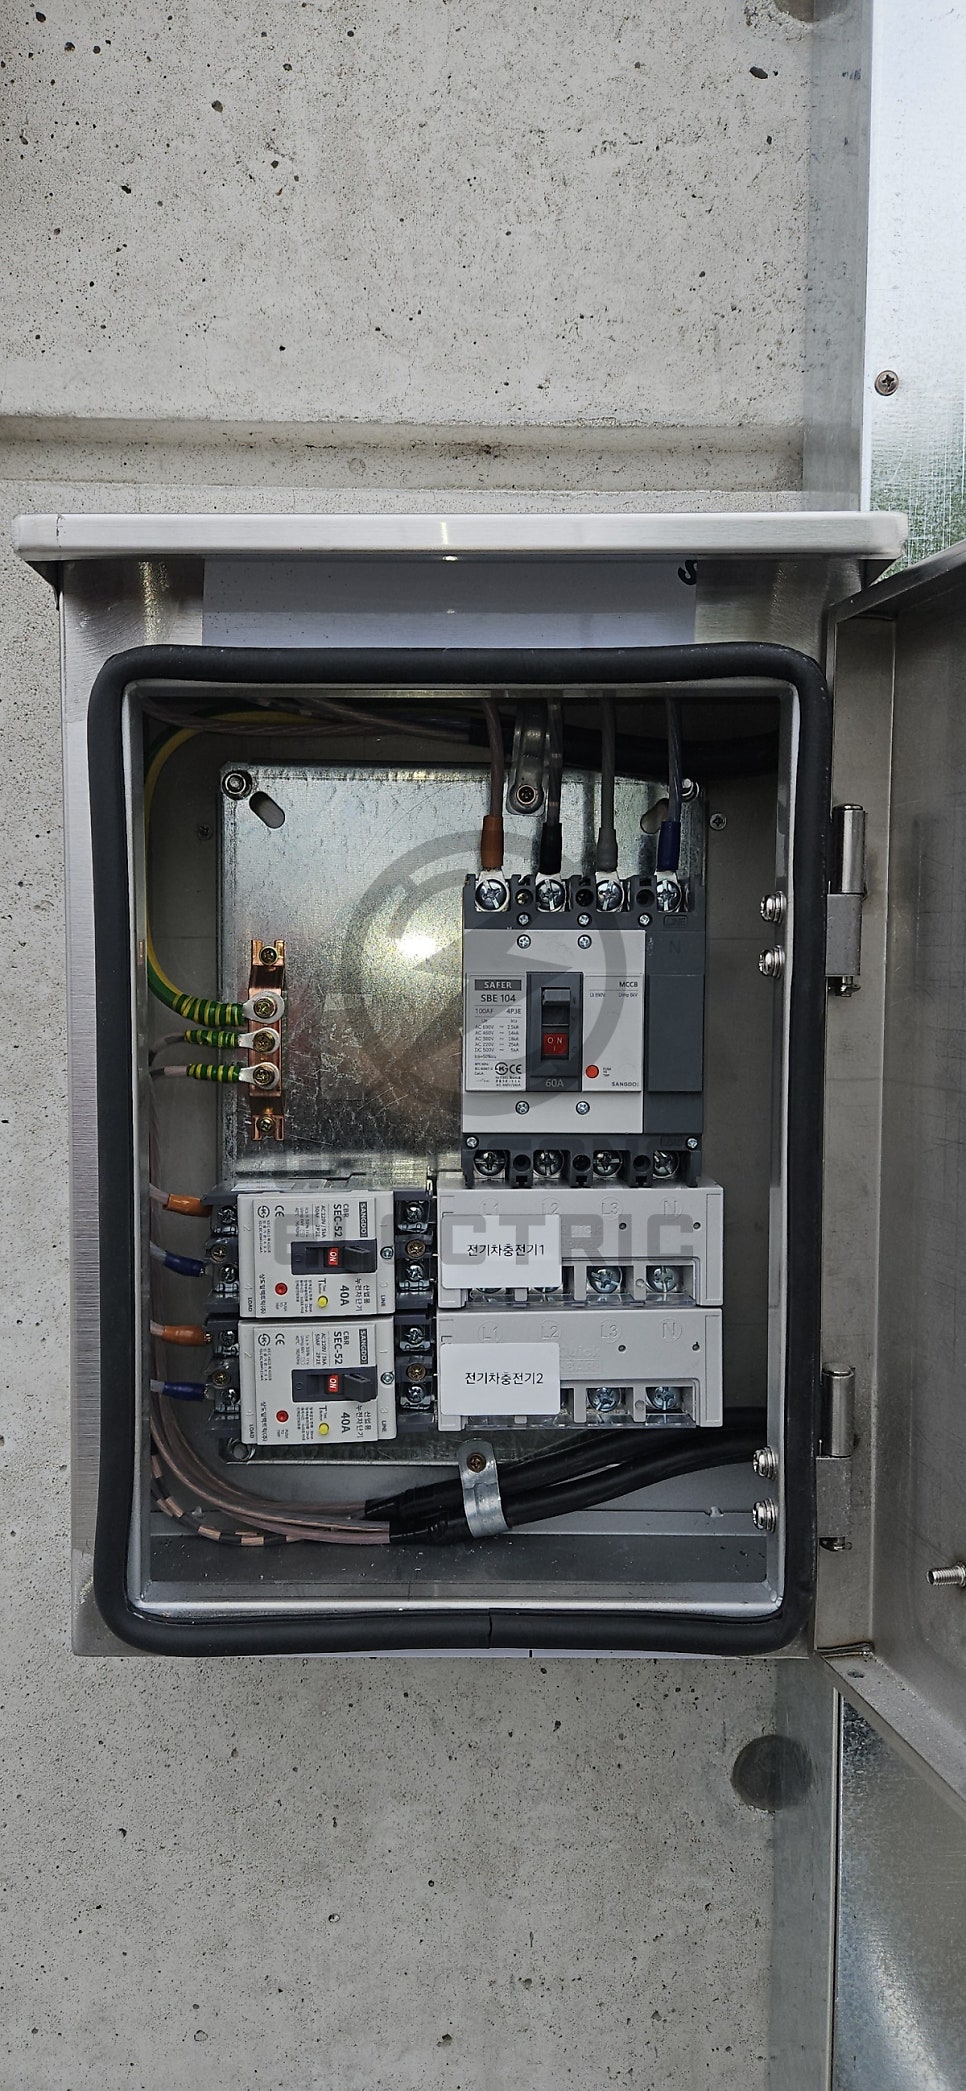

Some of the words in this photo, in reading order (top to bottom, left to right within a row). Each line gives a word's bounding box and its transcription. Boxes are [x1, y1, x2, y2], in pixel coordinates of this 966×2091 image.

[481, 994, 498, 1002] SBE
[501, 994, 516, 1002] 104
[546, 1079, 564, 1087] 60A
[333, 1204, 342, 1238] SEC-52
[329, 1251, 337, 1262] ON
[467, 1244, 545, 1257] 전기차충전기1
[340, 1285, 350, 1306] 40A
[355, 1278, 363, 1312] 누전차단기
[601, 1324, 618, 1337] L3
[334, 1331, 342, 1365] SEC-52
[329, 1378, 337, 1389] ON
[465, 1372, 544, 1385] 전기차충전기2
[341, 1412, 351, 1433] 40A
[356, 1405, 364, 1438] 누전차단기
